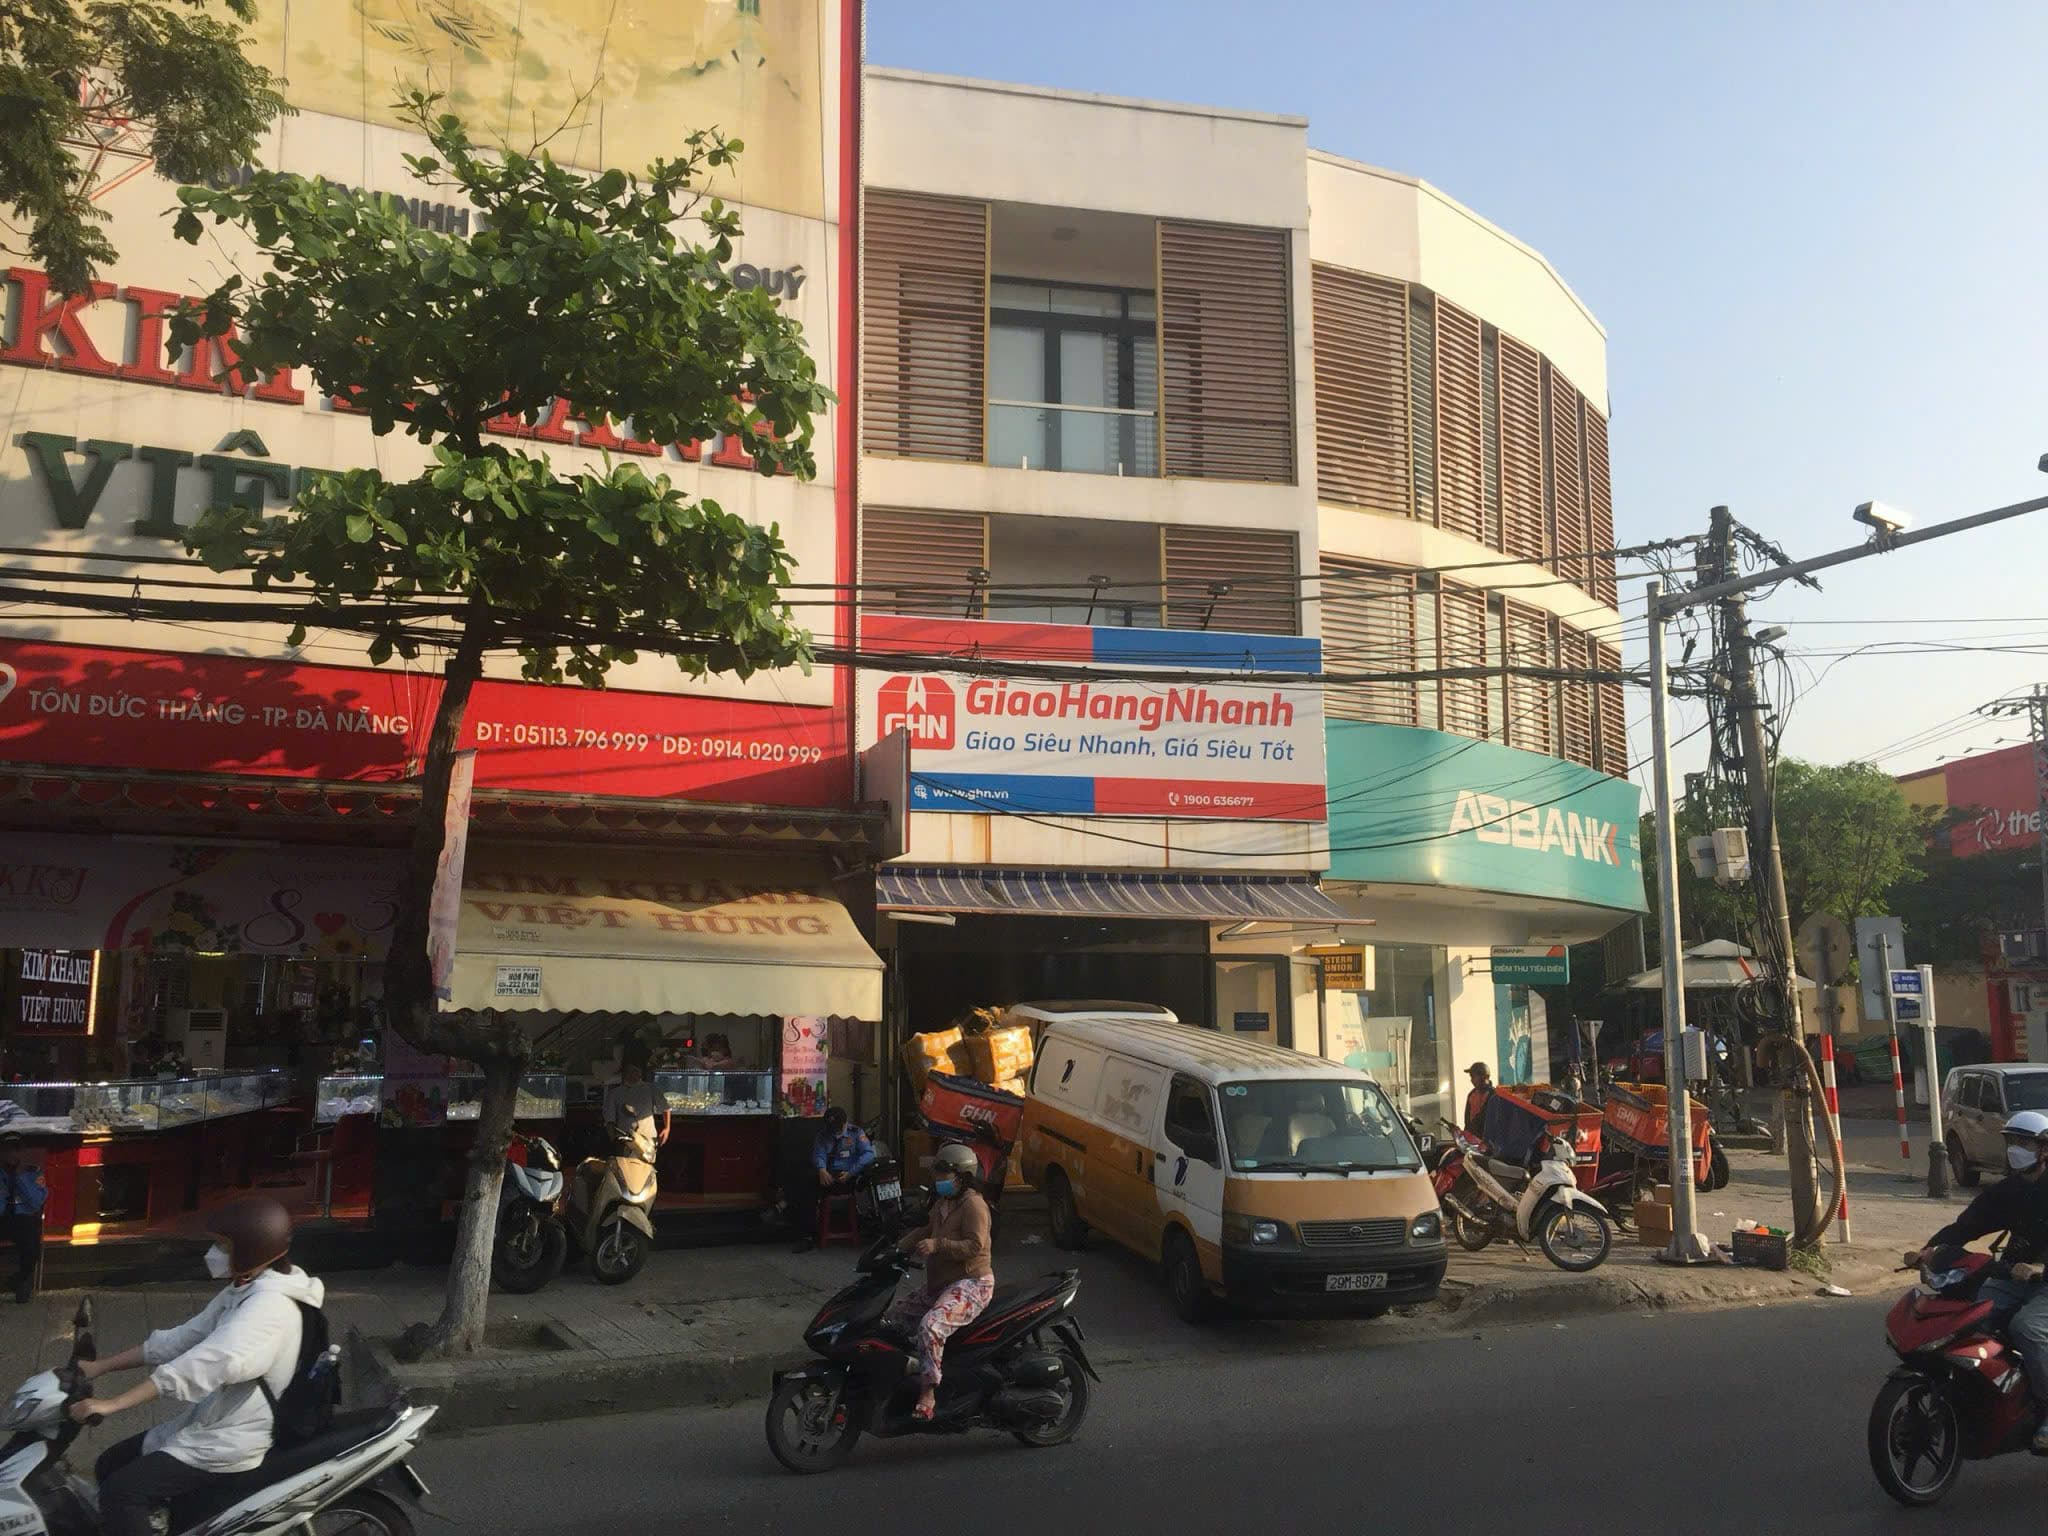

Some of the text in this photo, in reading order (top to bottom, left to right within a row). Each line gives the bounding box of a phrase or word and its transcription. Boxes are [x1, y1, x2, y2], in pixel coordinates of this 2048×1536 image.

[732, 263, 806, 299] QUÝ
[28, 687, 80, 714] TÔN
[89, 690, 147, 718] ĐỨC
[157, 692, 245, 724] THẮNG
[966, 679, 1294, 731] GiaoHangNhanh
[884, 713, 947, 740] GHN
[966, 731, 1294, 761] Giao Siêu Nhanh, Giá Siêu Tốt
[933, 786, 1009, 801] www.ghn.vn
[1183, 795, 1254, 807] 1900 636677
[1448, 790, 1620, 867] ABBANK
[2008, 810, 2041, 836] the
[465, 900, 830, 937] VIỆT HÙNG
[21, 951, 48, 981] KIM
[960, 1104, 998, 1123] GHN
[1616, 1107, 1640, 1126] GHN
